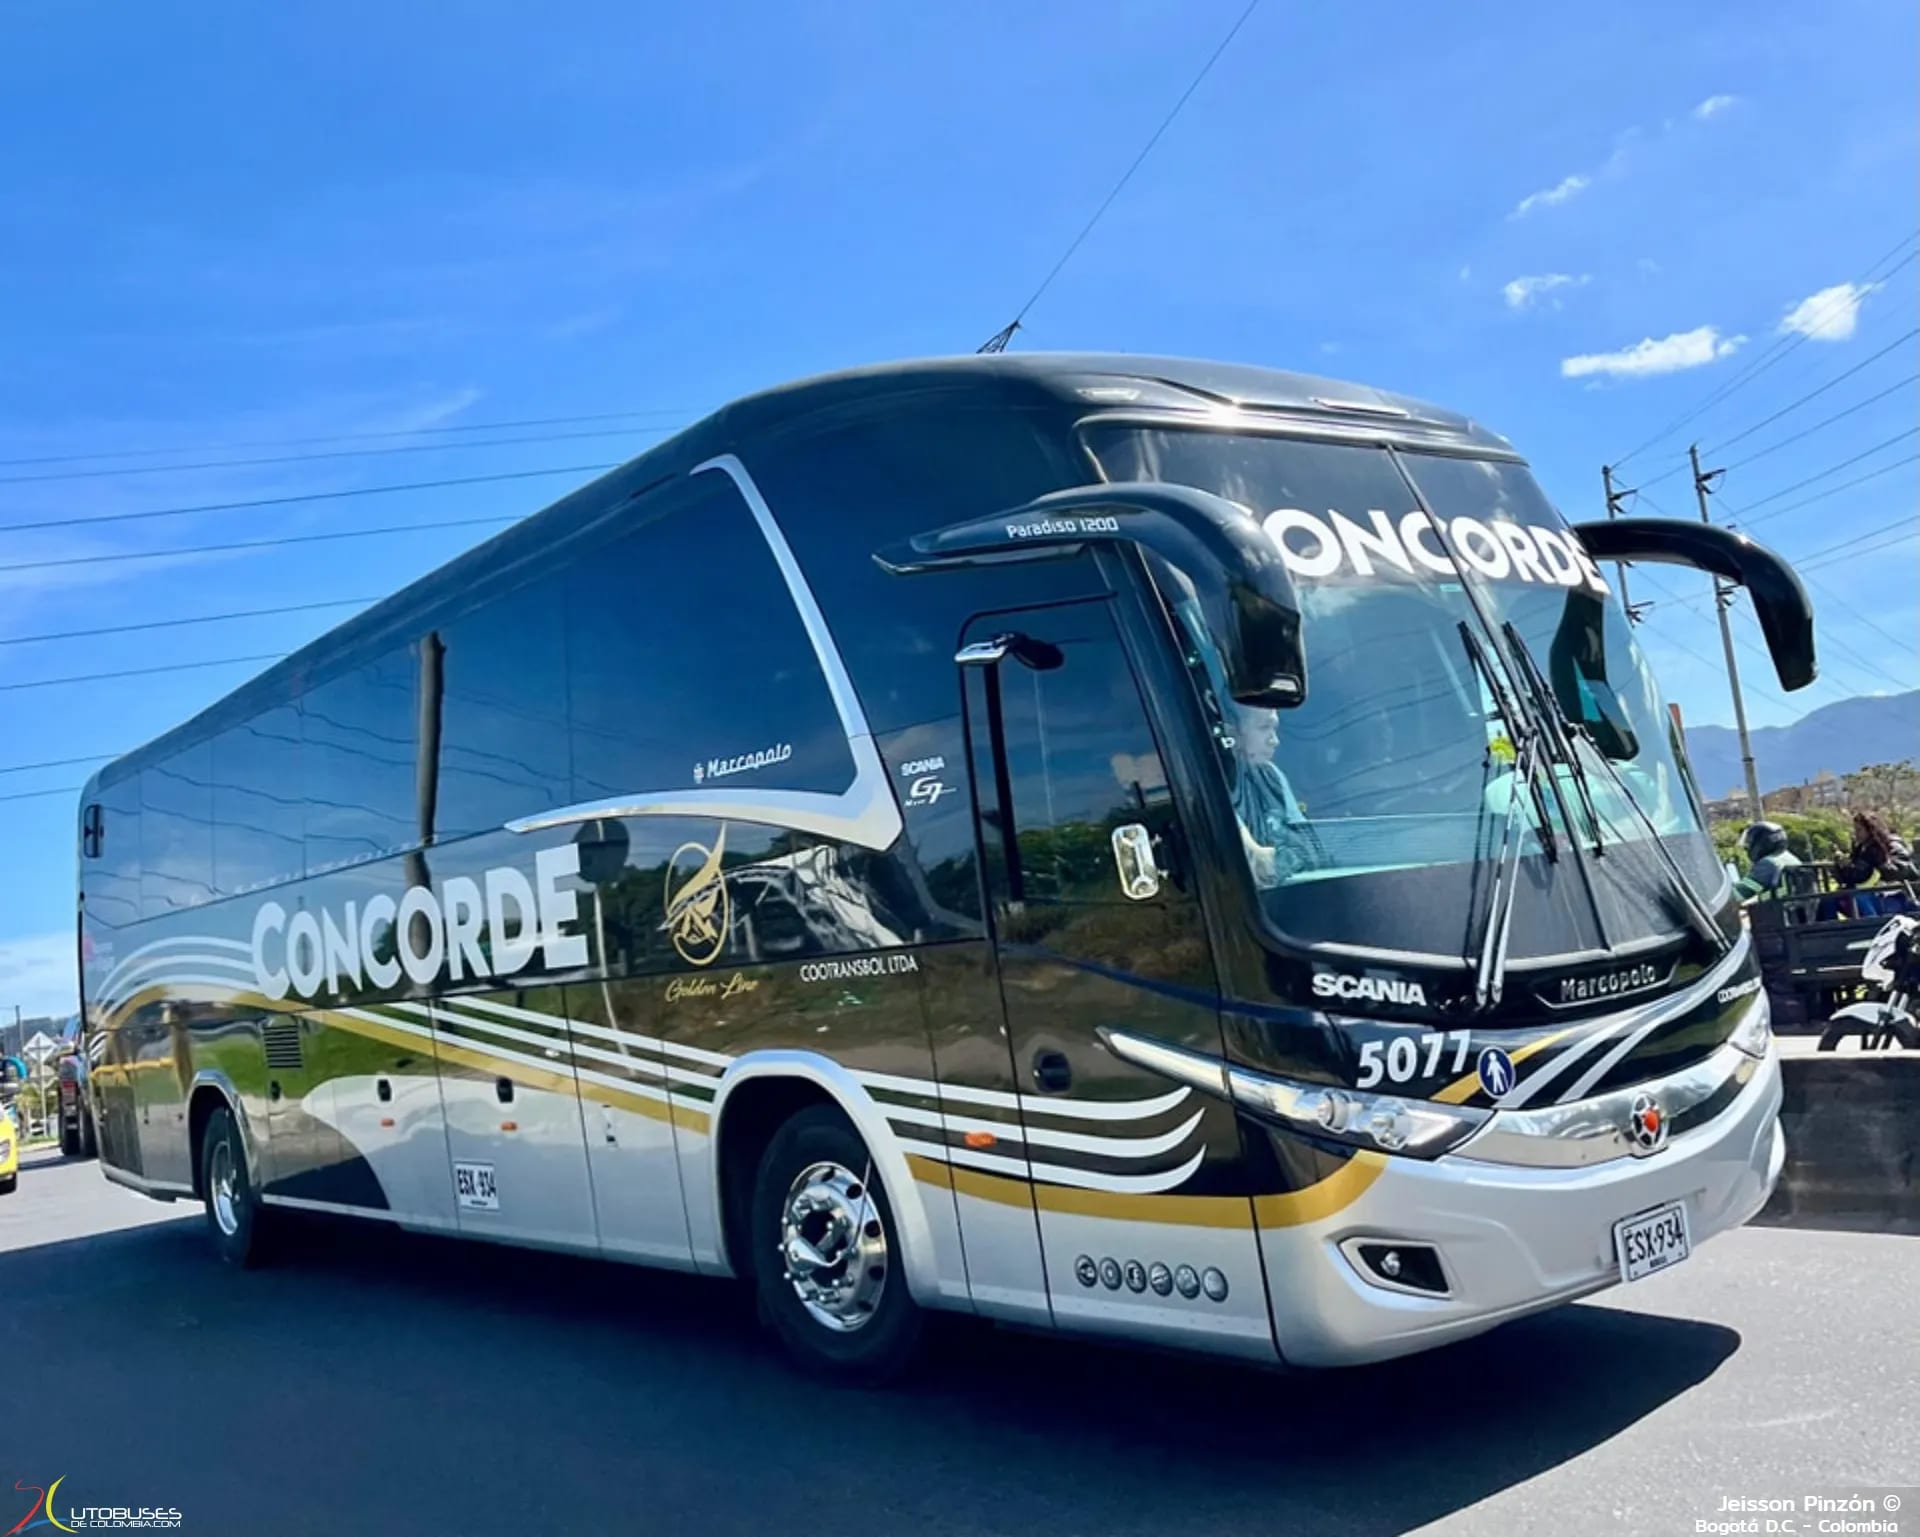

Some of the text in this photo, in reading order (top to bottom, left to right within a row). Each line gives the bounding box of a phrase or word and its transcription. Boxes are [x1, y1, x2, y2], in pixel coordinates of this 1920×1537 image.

[1005, 516, 1119, 538] Paradiso 1200
[1226, 499, 1611, 595] ONCORDE
[706, 743, 792, 778] Marcopolo
[901, 756, 945, 776] SCANIA
[252, 842, 588, 1000] CONCORDE
[800, 954, 919, 982] COOTRANSBOL LTDA
[1559, 963, 1656, 1001] Marcopolo
[1311, 972, 1427, 1007] SCANIA
[1356, 1029, 1471, 1089] 5077
